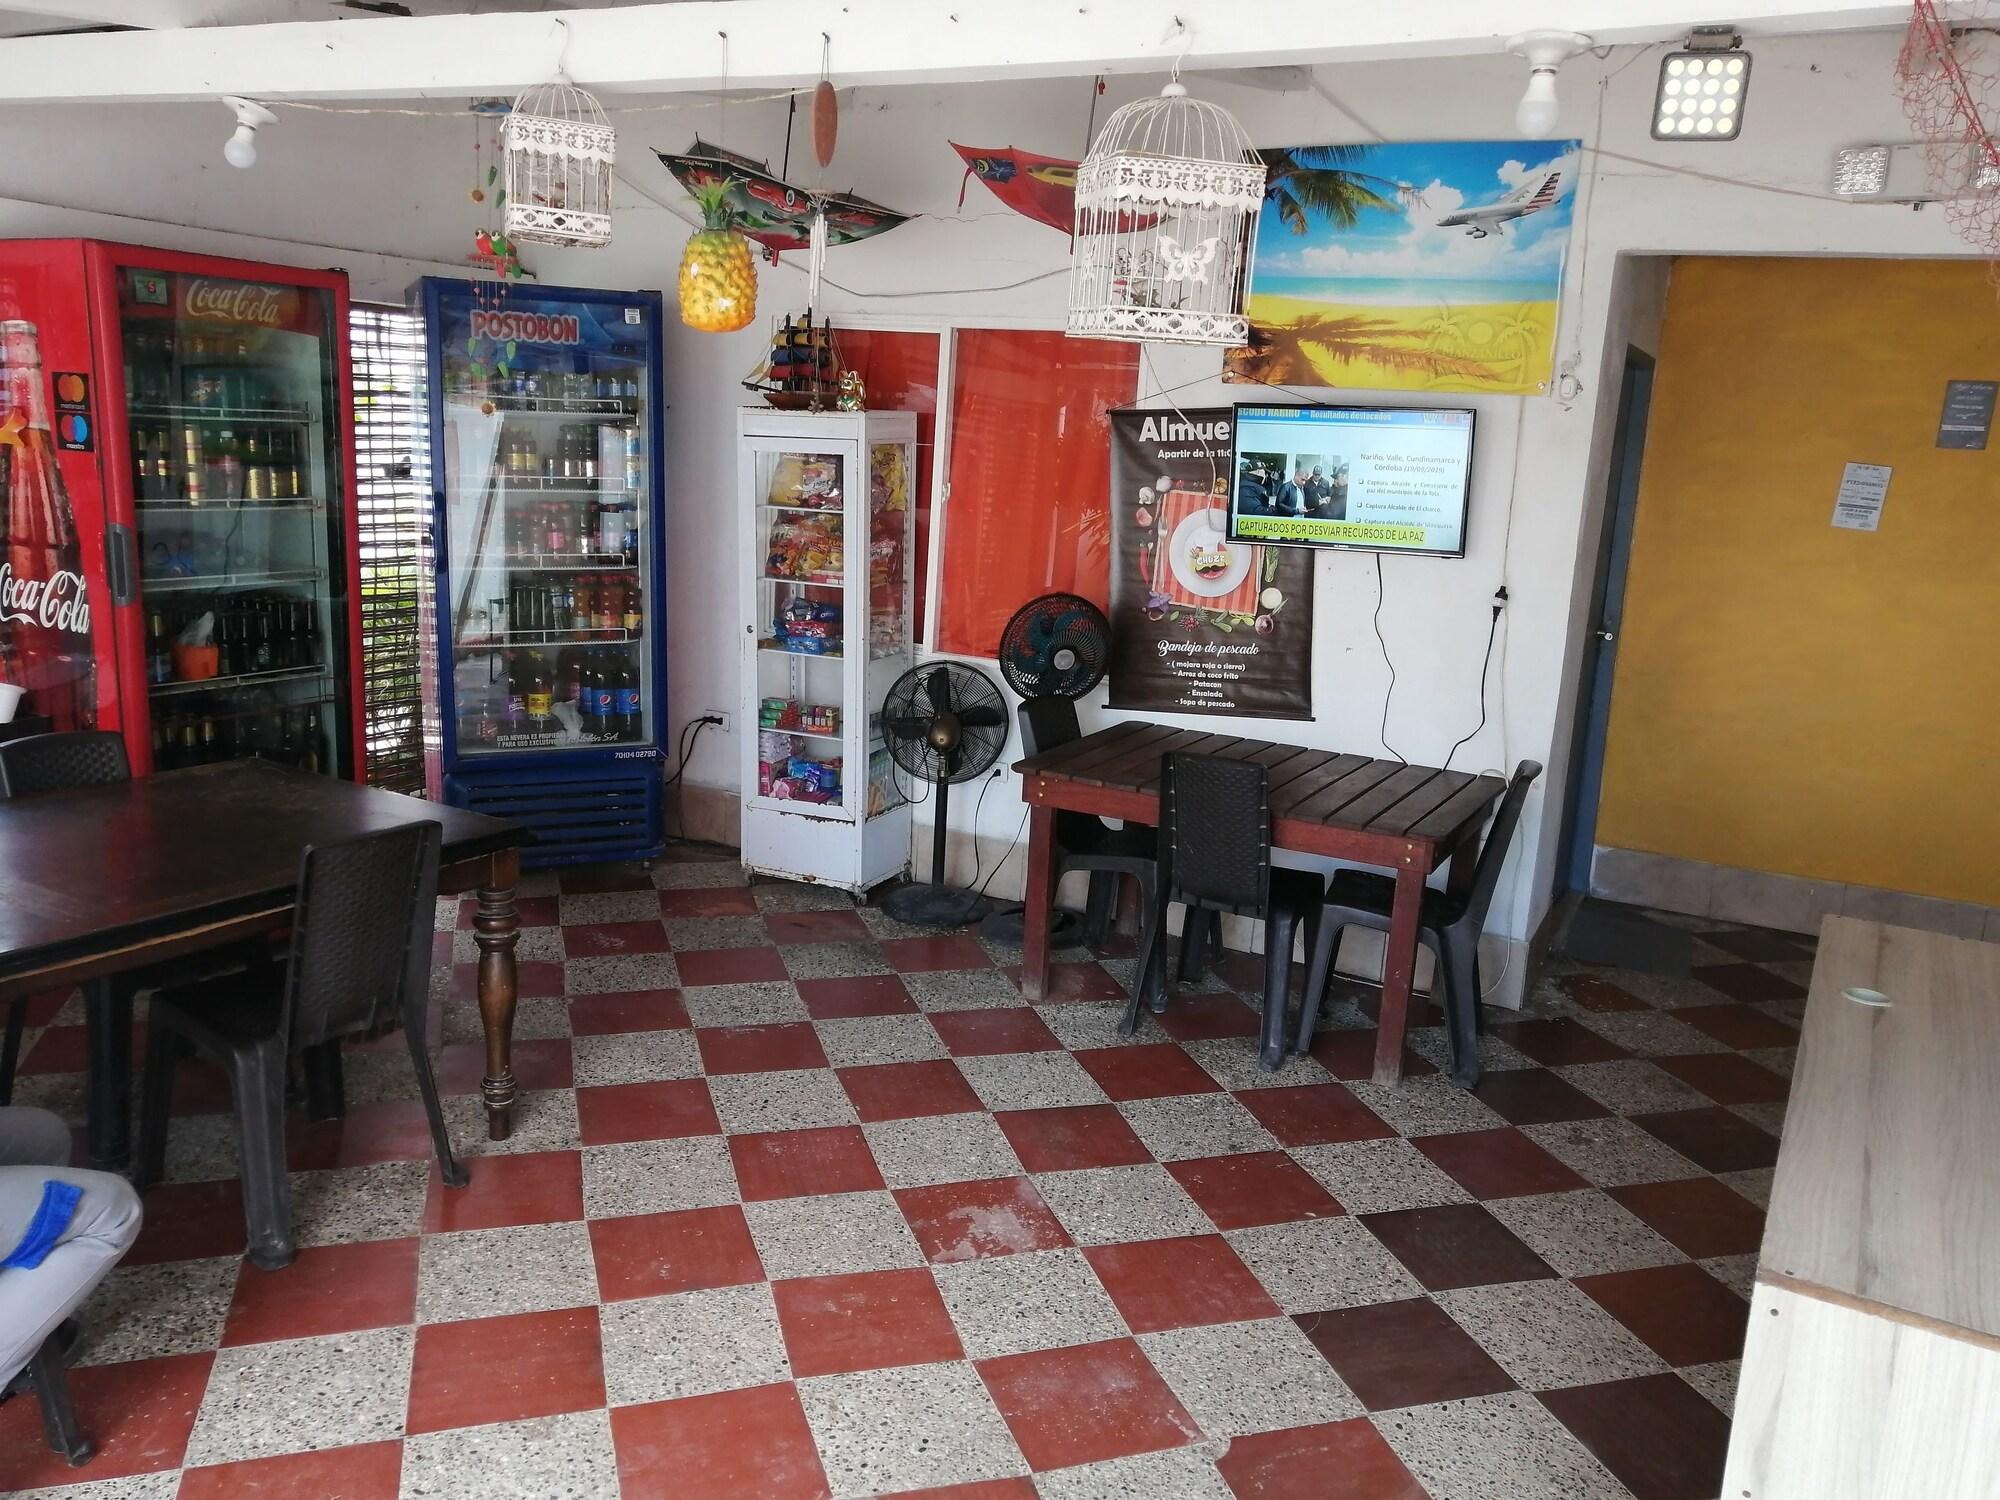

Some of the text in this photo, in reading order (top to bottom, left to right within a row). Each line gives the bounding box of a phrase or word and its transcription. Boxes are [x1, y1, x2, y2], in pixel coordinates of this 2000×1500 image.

[185, 279, 280, 323] Coca-Cola
[470, 309, 579, 345] POSTOBON
[1139, 416, 1232, 442] Almue
[1157, 449, 1190, 459] Apartir
[1192, 449, 1204, 458] de
[1406, 455, 1455, 464] Cundinamarca
[1365, 503, 1387, 511] Captura
[1387, 503, 1407, 511] Alcalde
[1239, 521, 1424, 542] CAPTURADOS POR DESVIAR RECURSOS DE LA PAZ
[1157, 640, 1259, 658] Bandeja de pescado
[1177, 670, 1196, 678] Arroz
[1223, 671, 1239, 679] frito
[1193, 680, 1222, 688] Patacon
[1191, 690, 1223, 698] Ensalada
[1180, 698, 1196, 706] Sopa
[1207, 700, 1235, 708] pescado
